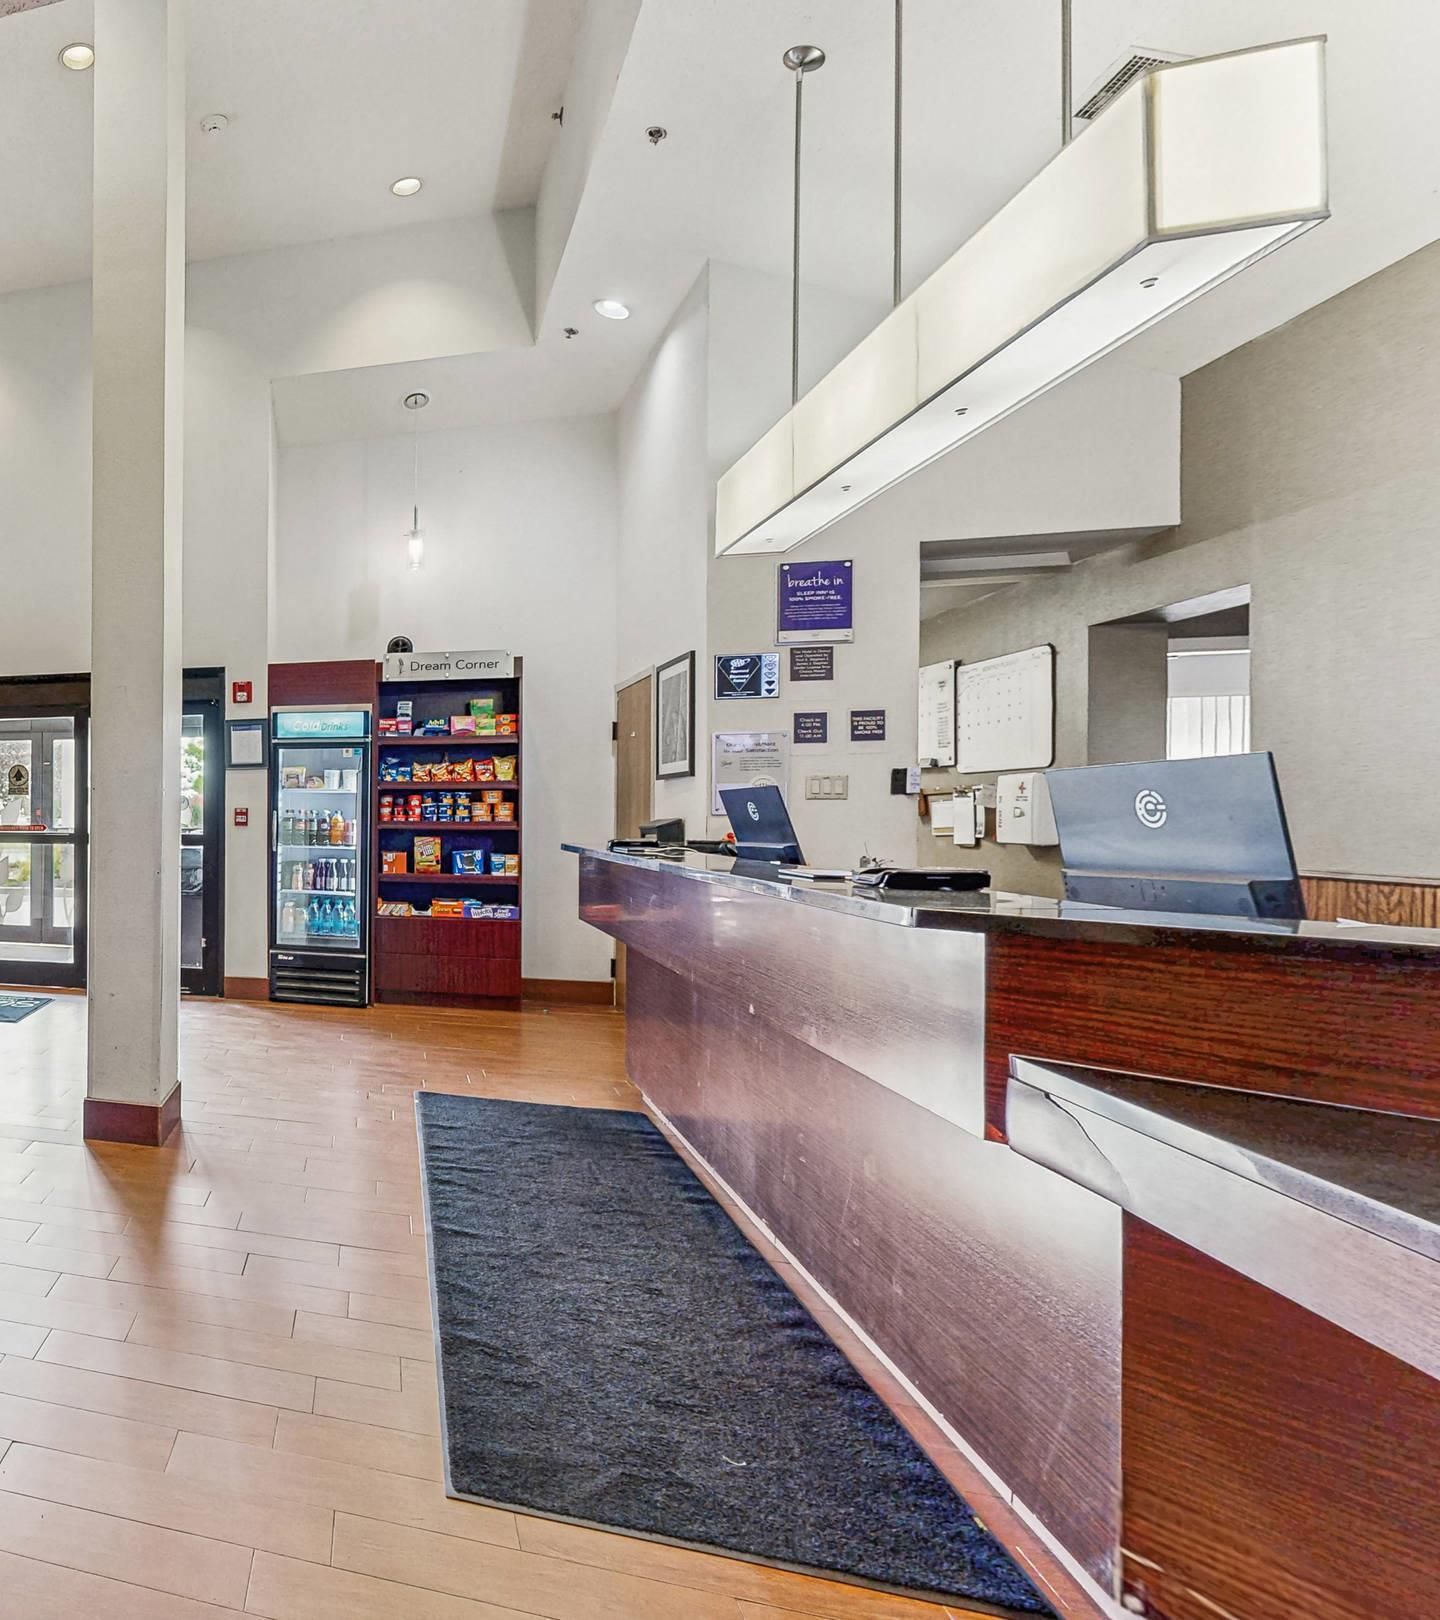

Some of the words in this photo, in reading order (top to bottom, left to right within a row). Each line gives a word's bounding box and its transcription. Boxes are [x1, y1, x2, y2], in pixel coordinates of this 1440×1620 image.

[787, 571, 831, 588] breathe
[833, 576, 844, 586] in
[410, 661, 451, 672] Dream
[455, 659, 500, 670] Corner
[320, 720, 349, 731] Drinks
